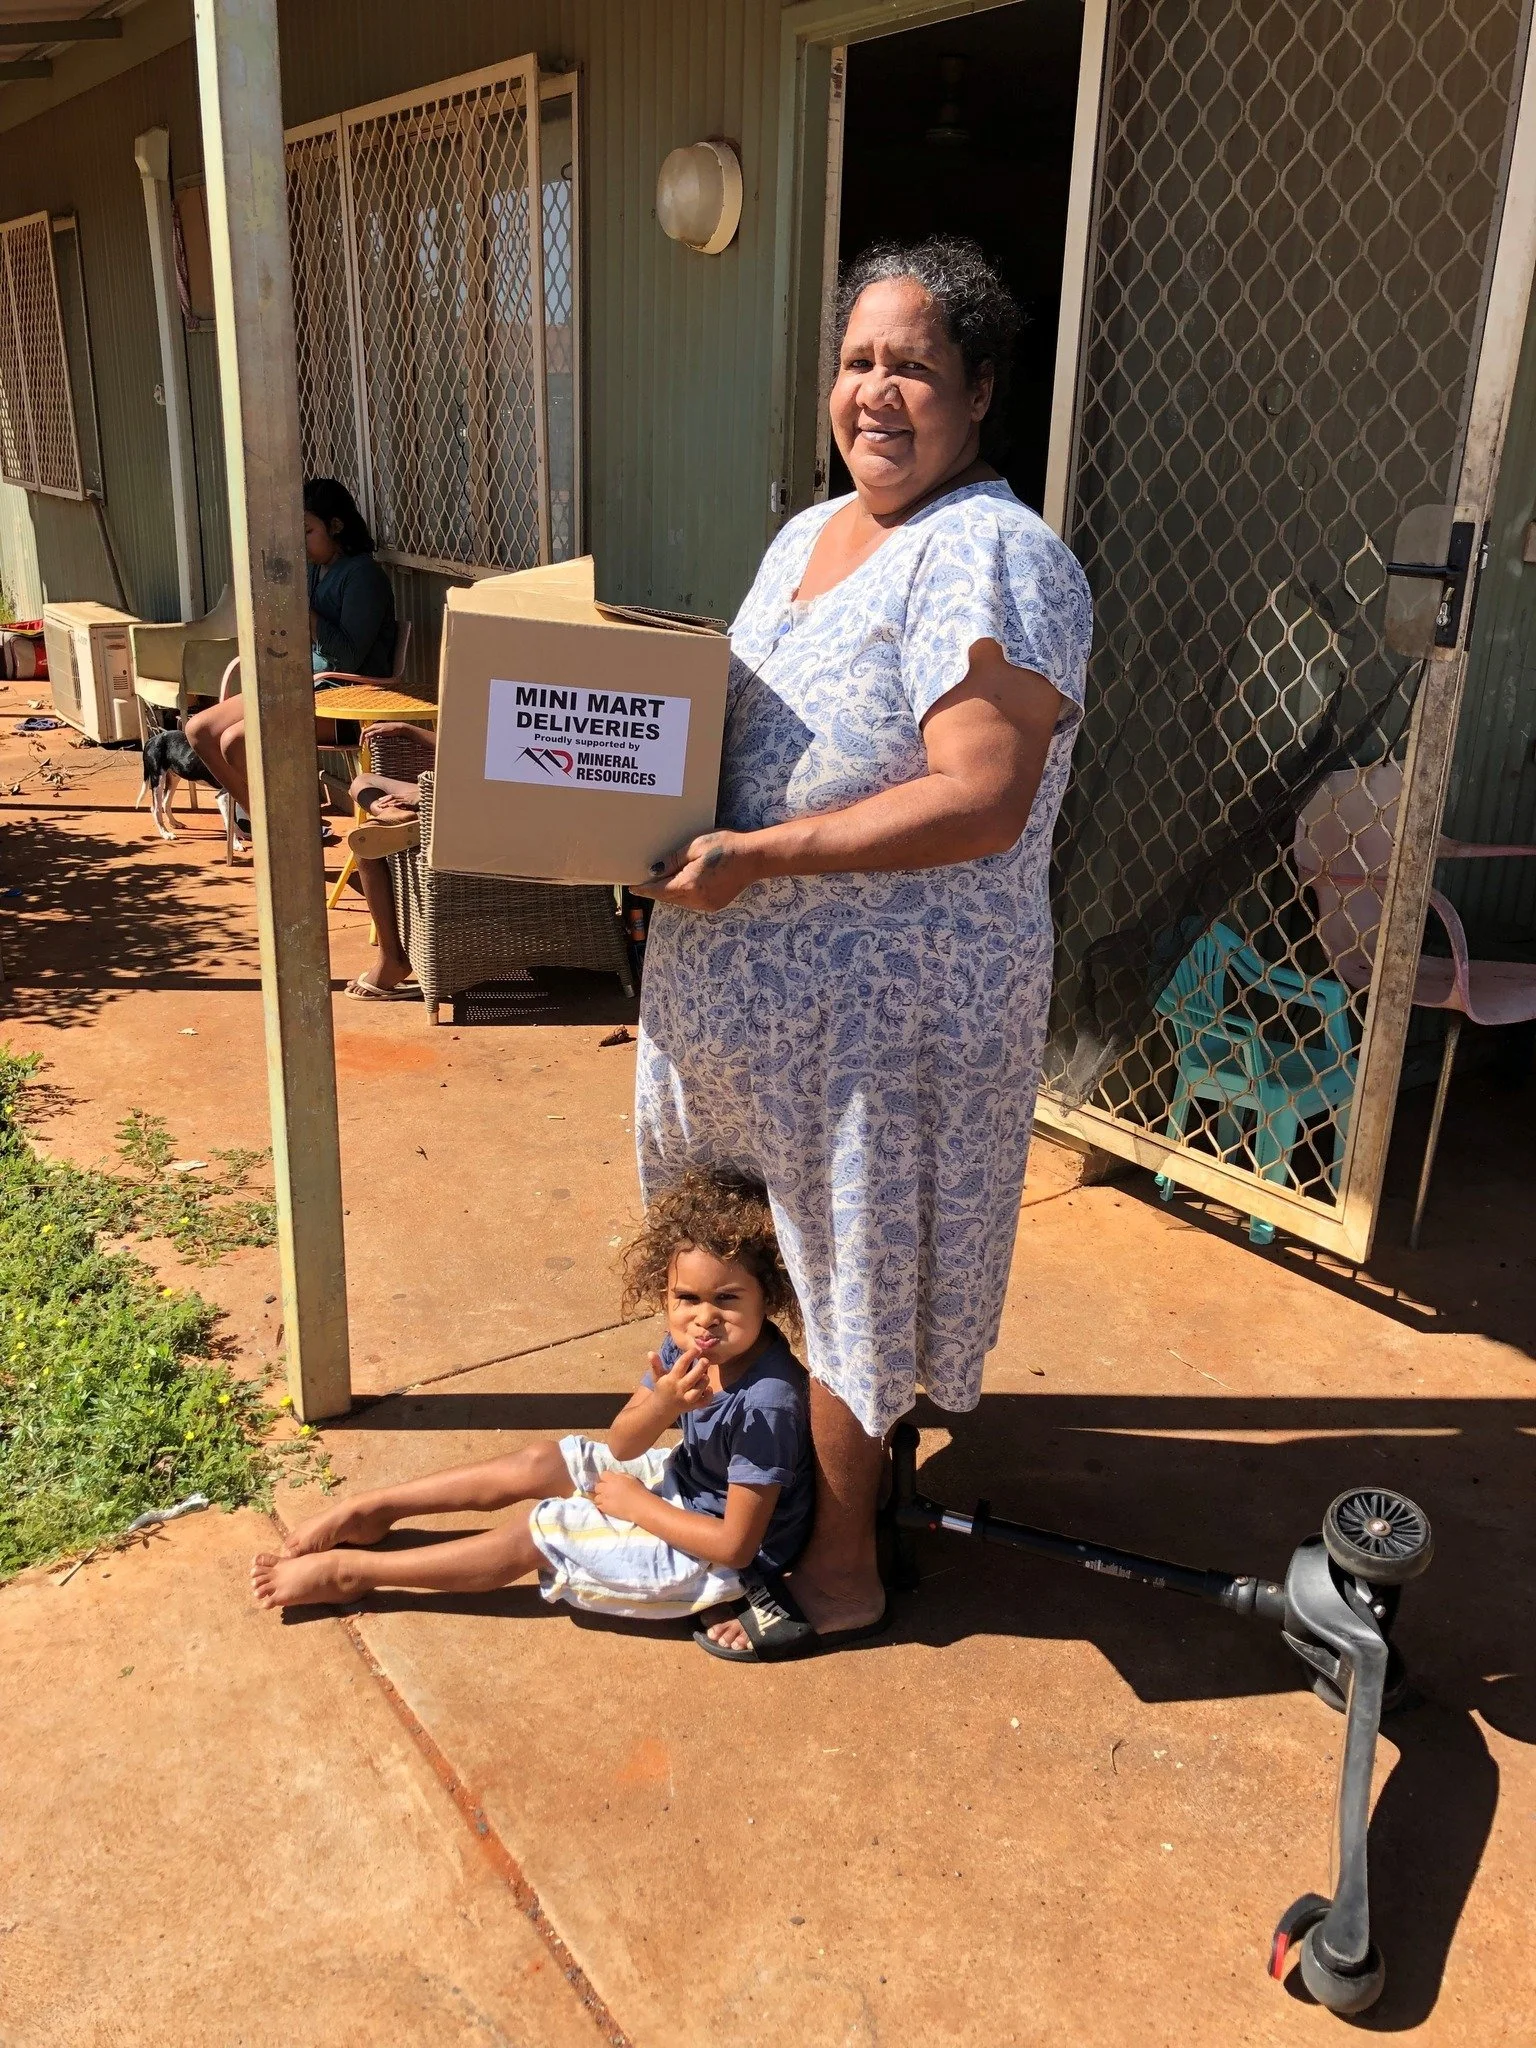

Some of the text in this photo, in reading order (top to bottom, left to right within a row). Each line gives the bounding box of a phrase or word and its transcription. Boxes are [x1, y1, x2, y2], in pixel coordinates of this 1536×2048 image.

[516, 687, 665, 718] MINI MART
[517, 711, 660, 740] DELIVERIES
[534, 734, 640, 751] Proudly supported by
[577, 752, 638, 769] MINERAL
[576, 768, 656, 786] RESOURCES
